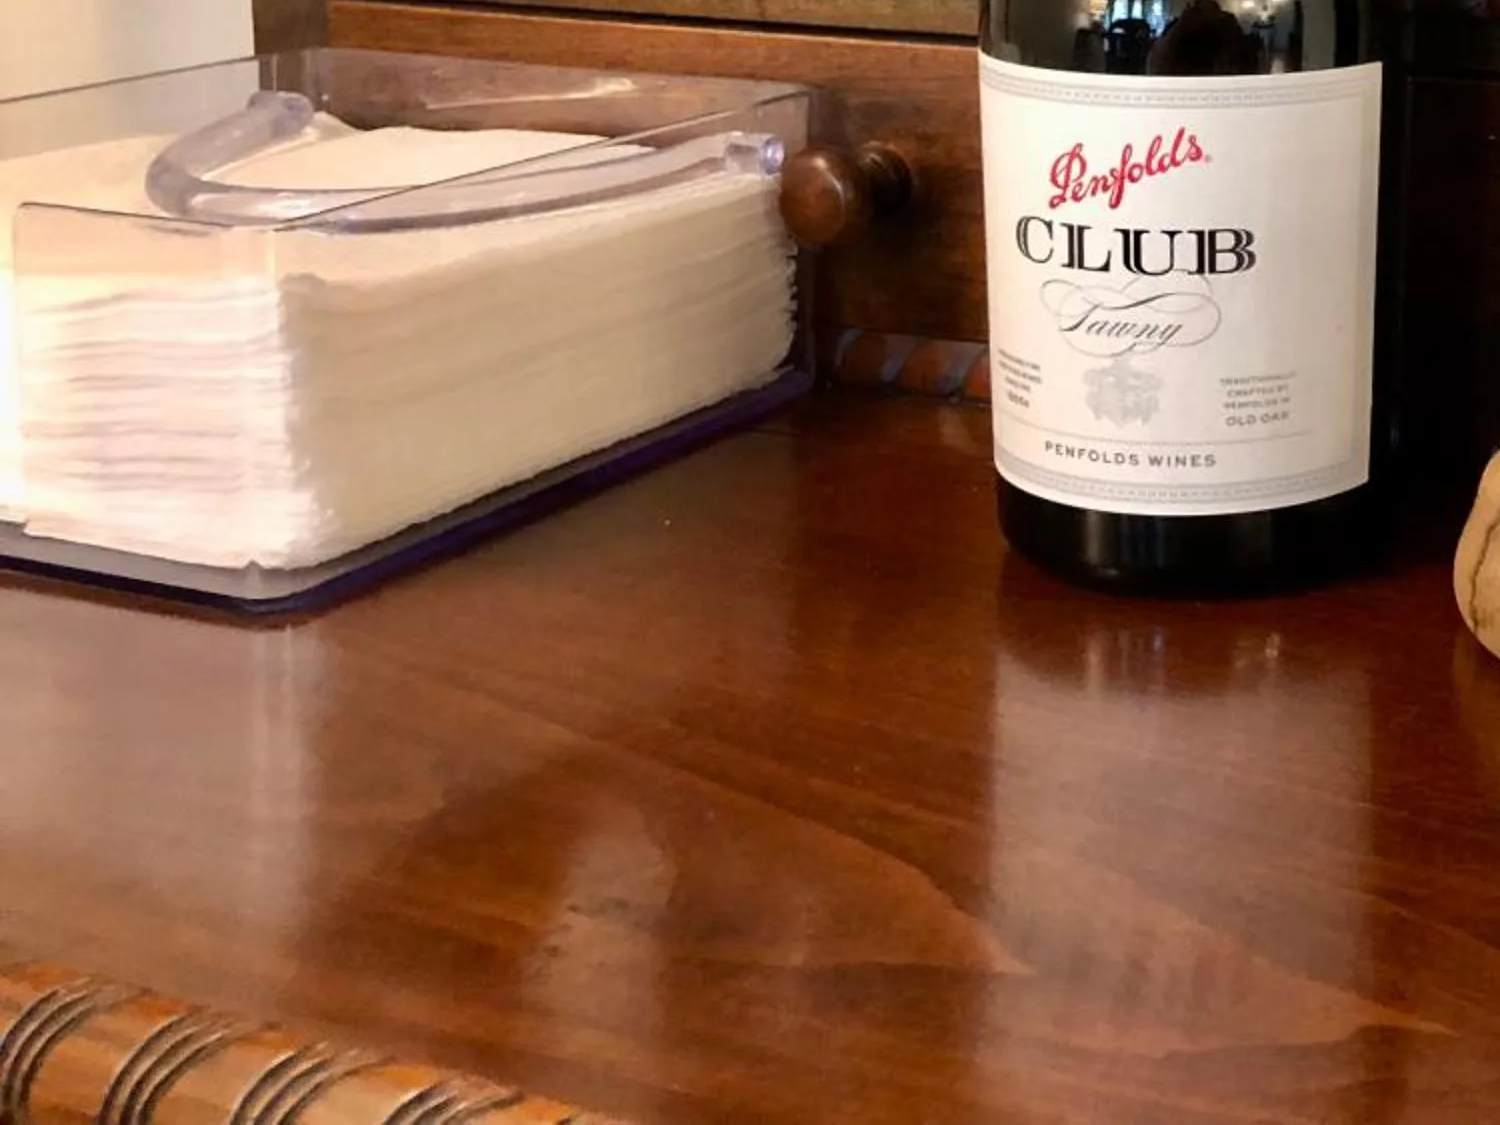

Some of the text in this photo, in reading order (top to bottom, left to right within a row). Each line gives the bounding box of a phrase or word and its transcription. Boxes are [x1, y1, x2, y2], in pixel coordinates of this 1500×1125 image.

[1048, 127, 1203, 209] Penfolds
[1016, 216, 1256, 276] CLUB
[1050, 292, 1219, 354] Tawny
[1045, 440, 1217, 468] PENFOLDS WINES
